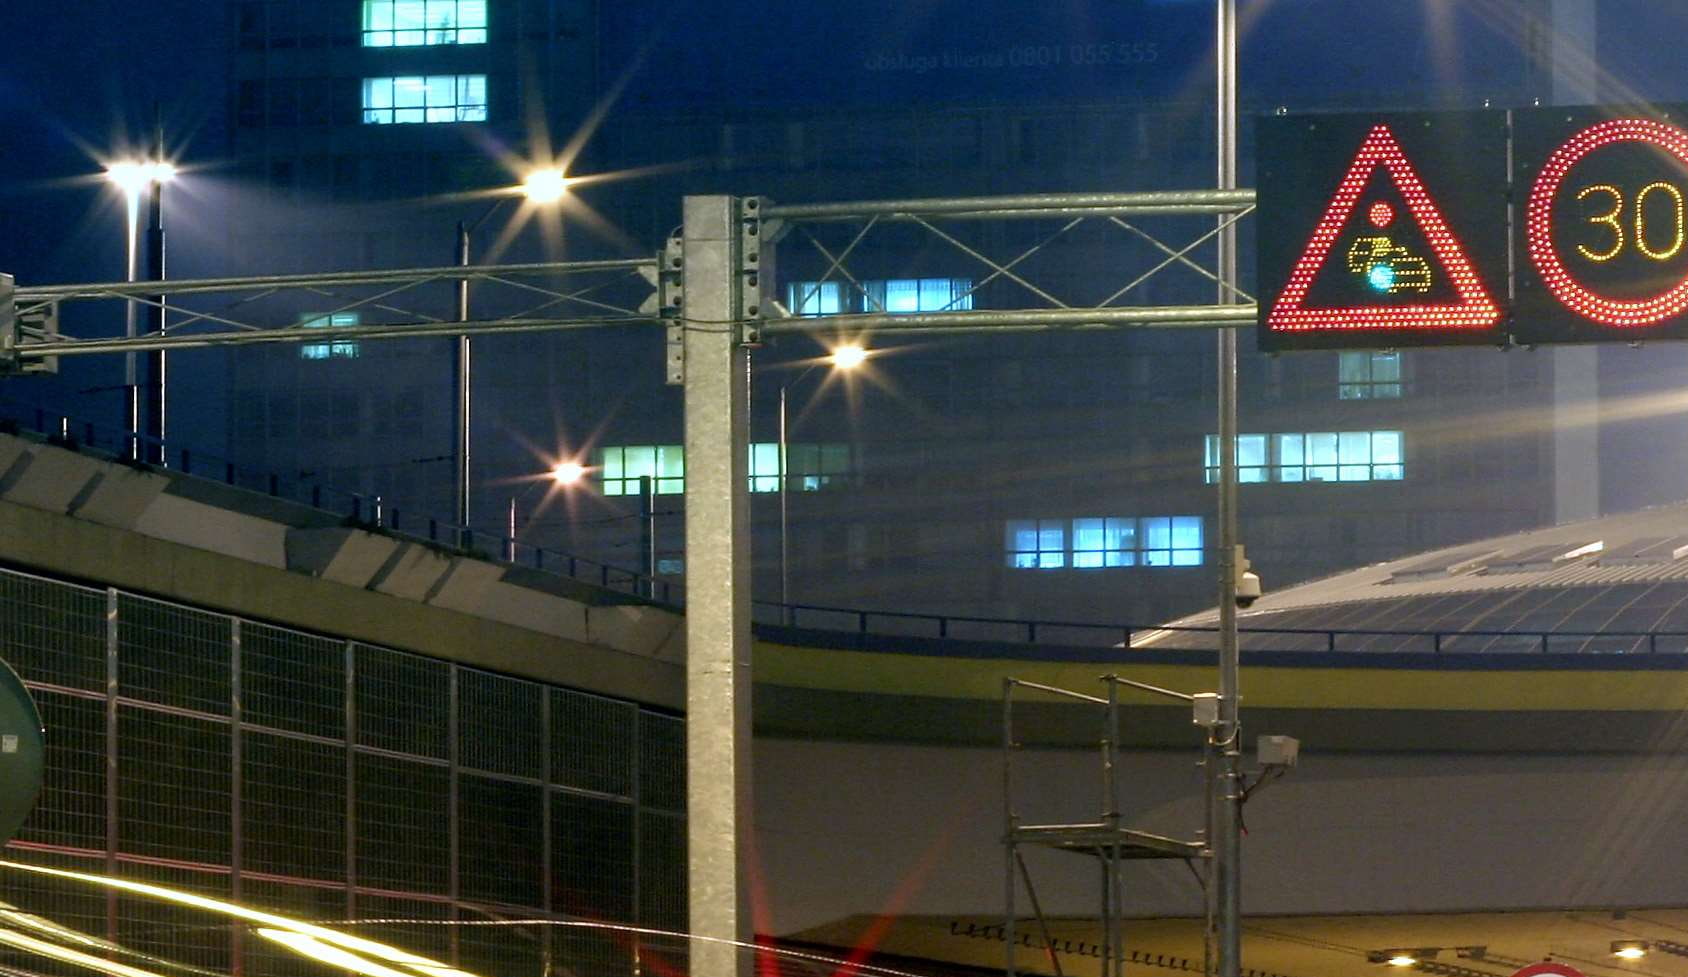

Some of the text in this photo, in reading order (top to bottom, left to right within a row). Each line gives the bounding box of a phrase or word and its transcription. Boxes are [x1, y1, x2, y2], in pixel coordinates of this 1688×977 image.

[1009, 45, 1061, 67] 0801
[1070, 43, 1112, 65] 055
[1118, 42, 1159, 63] 555
[1577, 182, 1683, 260] 30
